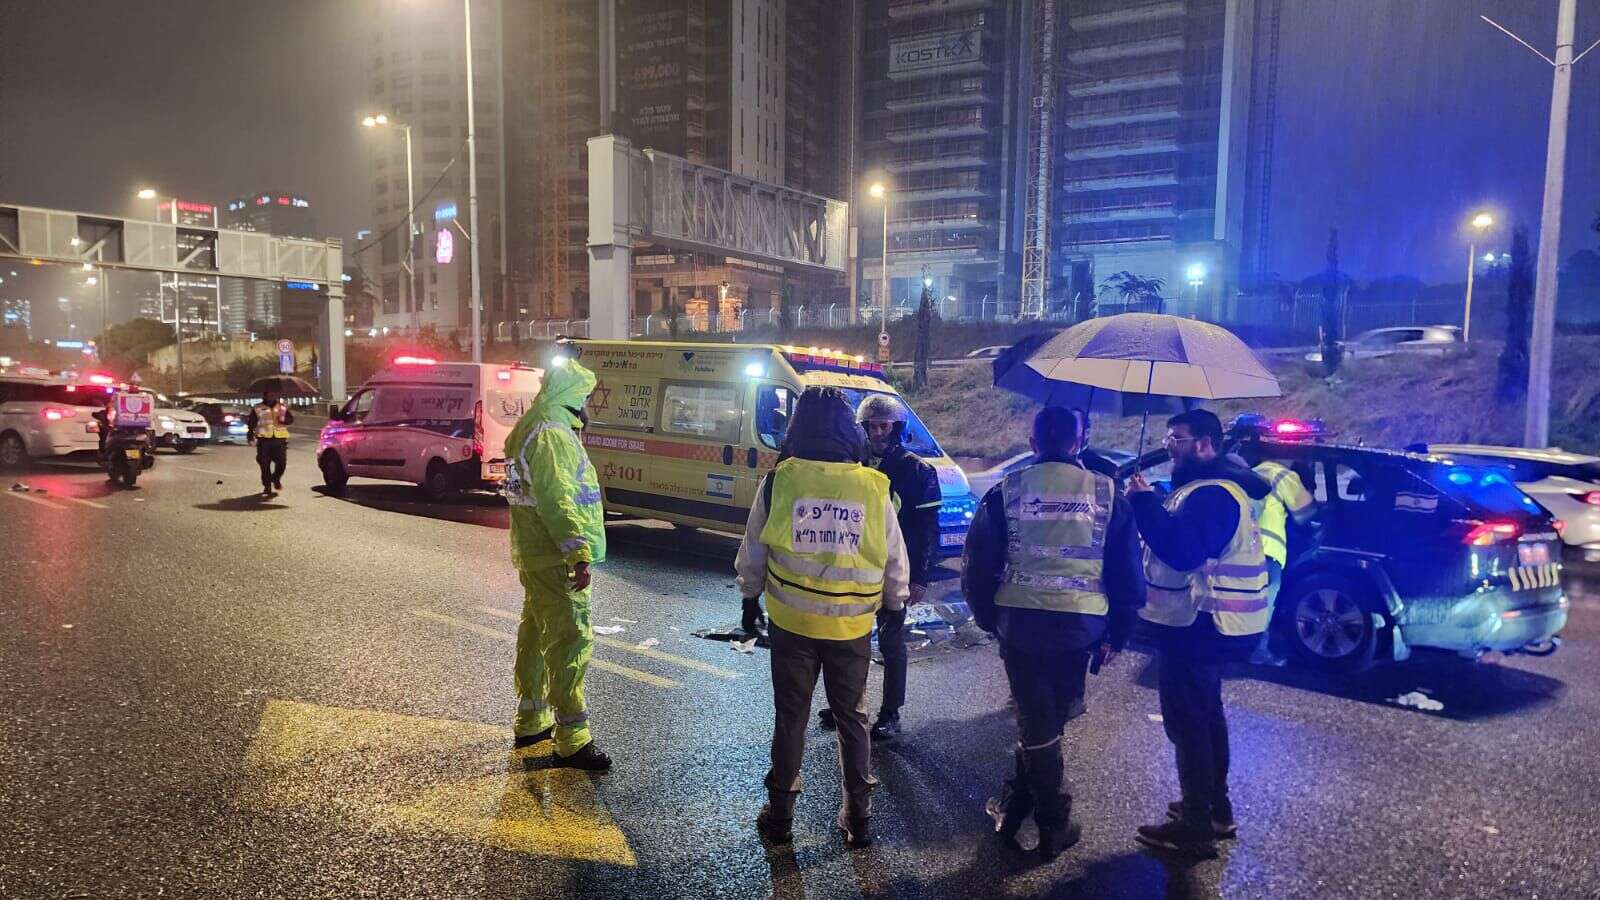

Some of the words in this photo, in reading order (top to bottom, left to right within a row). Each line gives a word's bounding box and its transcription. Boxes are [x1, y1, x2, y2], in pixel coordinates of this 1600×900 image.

[624, 384, 638, 394] דוד
[630, 397, 651, 408] אדום
[617, 407, 649, 420] בישראל
[618, 466, 643, 482] 101
